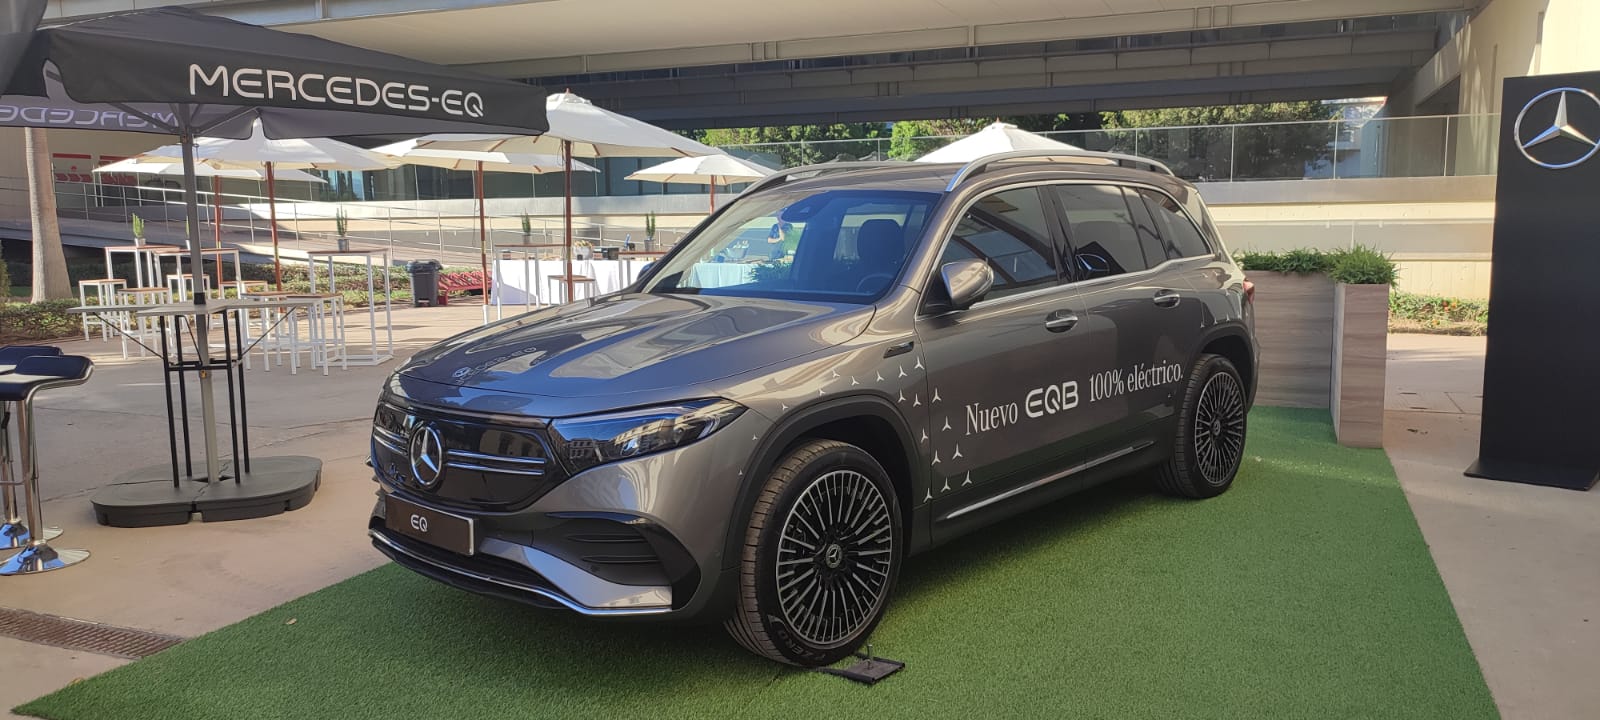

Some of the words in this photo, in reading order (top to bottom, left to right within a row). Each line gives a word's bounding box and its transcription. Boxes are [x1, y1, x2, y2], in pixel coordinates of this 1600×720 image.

[189, 63, 484, 118] MERCEDES-EQ
[965, 402, 1018, 435] Nuevo
[1025, 380, 1079, 419] EQB
[1089, 368, 1125, 402] 100%
[1127, 360, 1184, 393] eléctrico.
[410, 514, 428, 532] EQ
